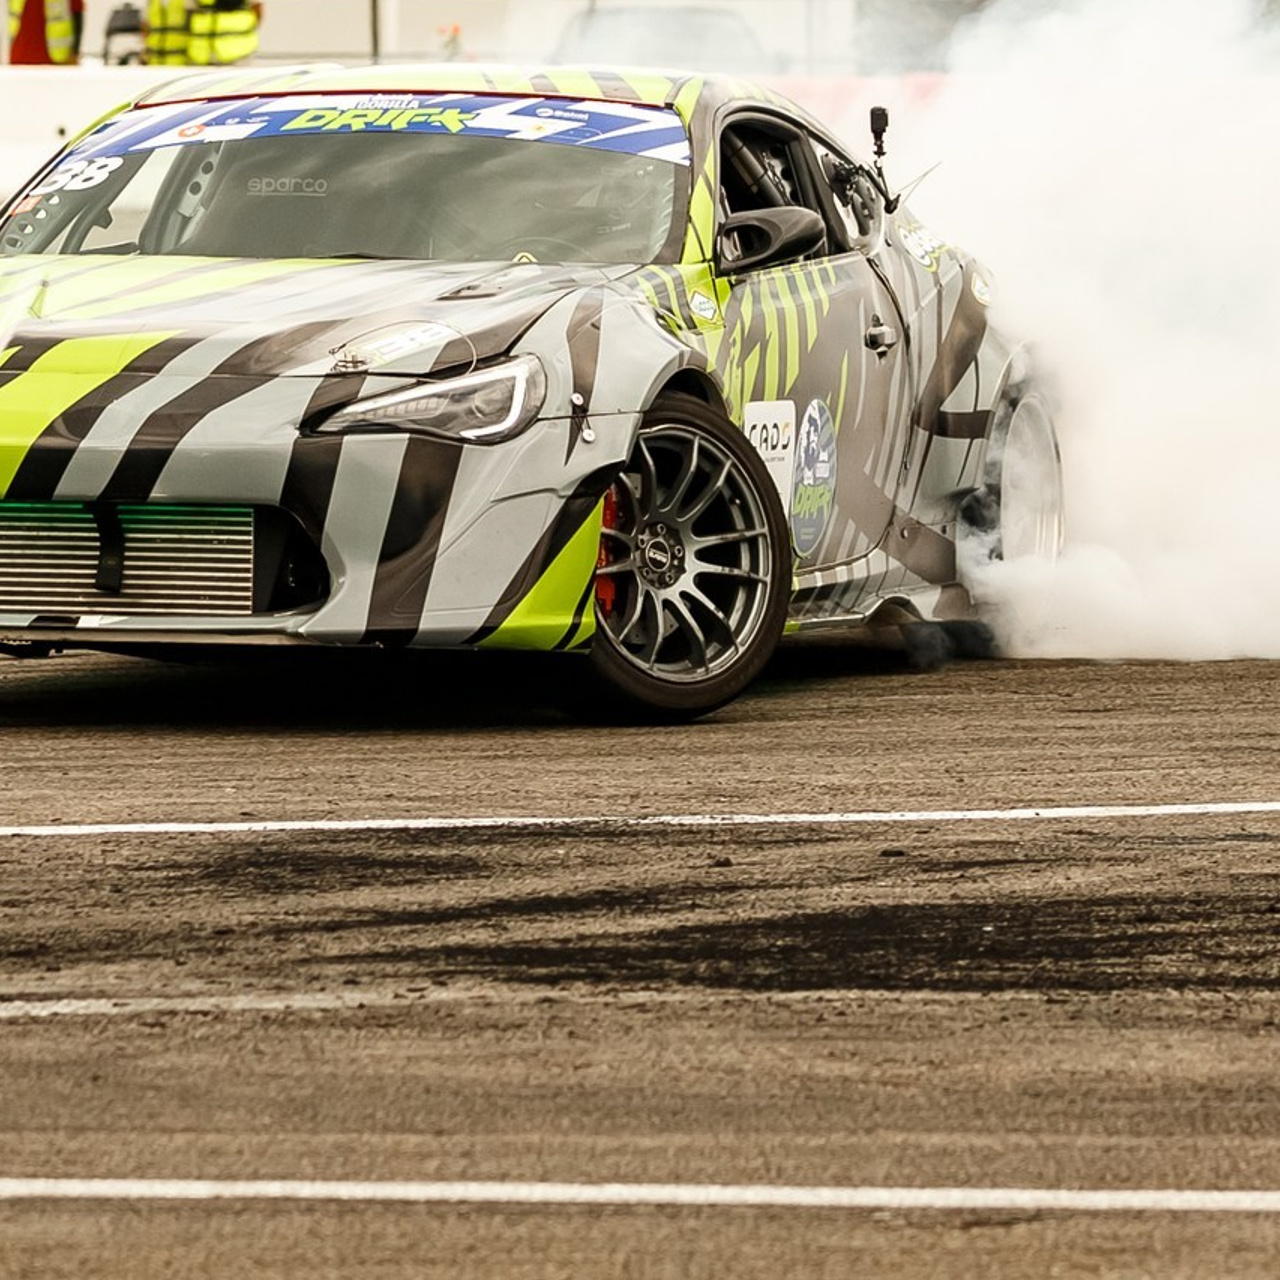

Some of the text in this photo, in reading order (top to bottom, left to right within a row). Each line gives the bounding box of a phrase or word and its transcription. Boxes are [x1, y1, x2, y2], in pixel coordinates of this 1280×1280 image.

[357, 99, 420, 109] GORILLA
[279, 108, 480, 133] DRIFT
[247, 176, 328, 197] sparco
